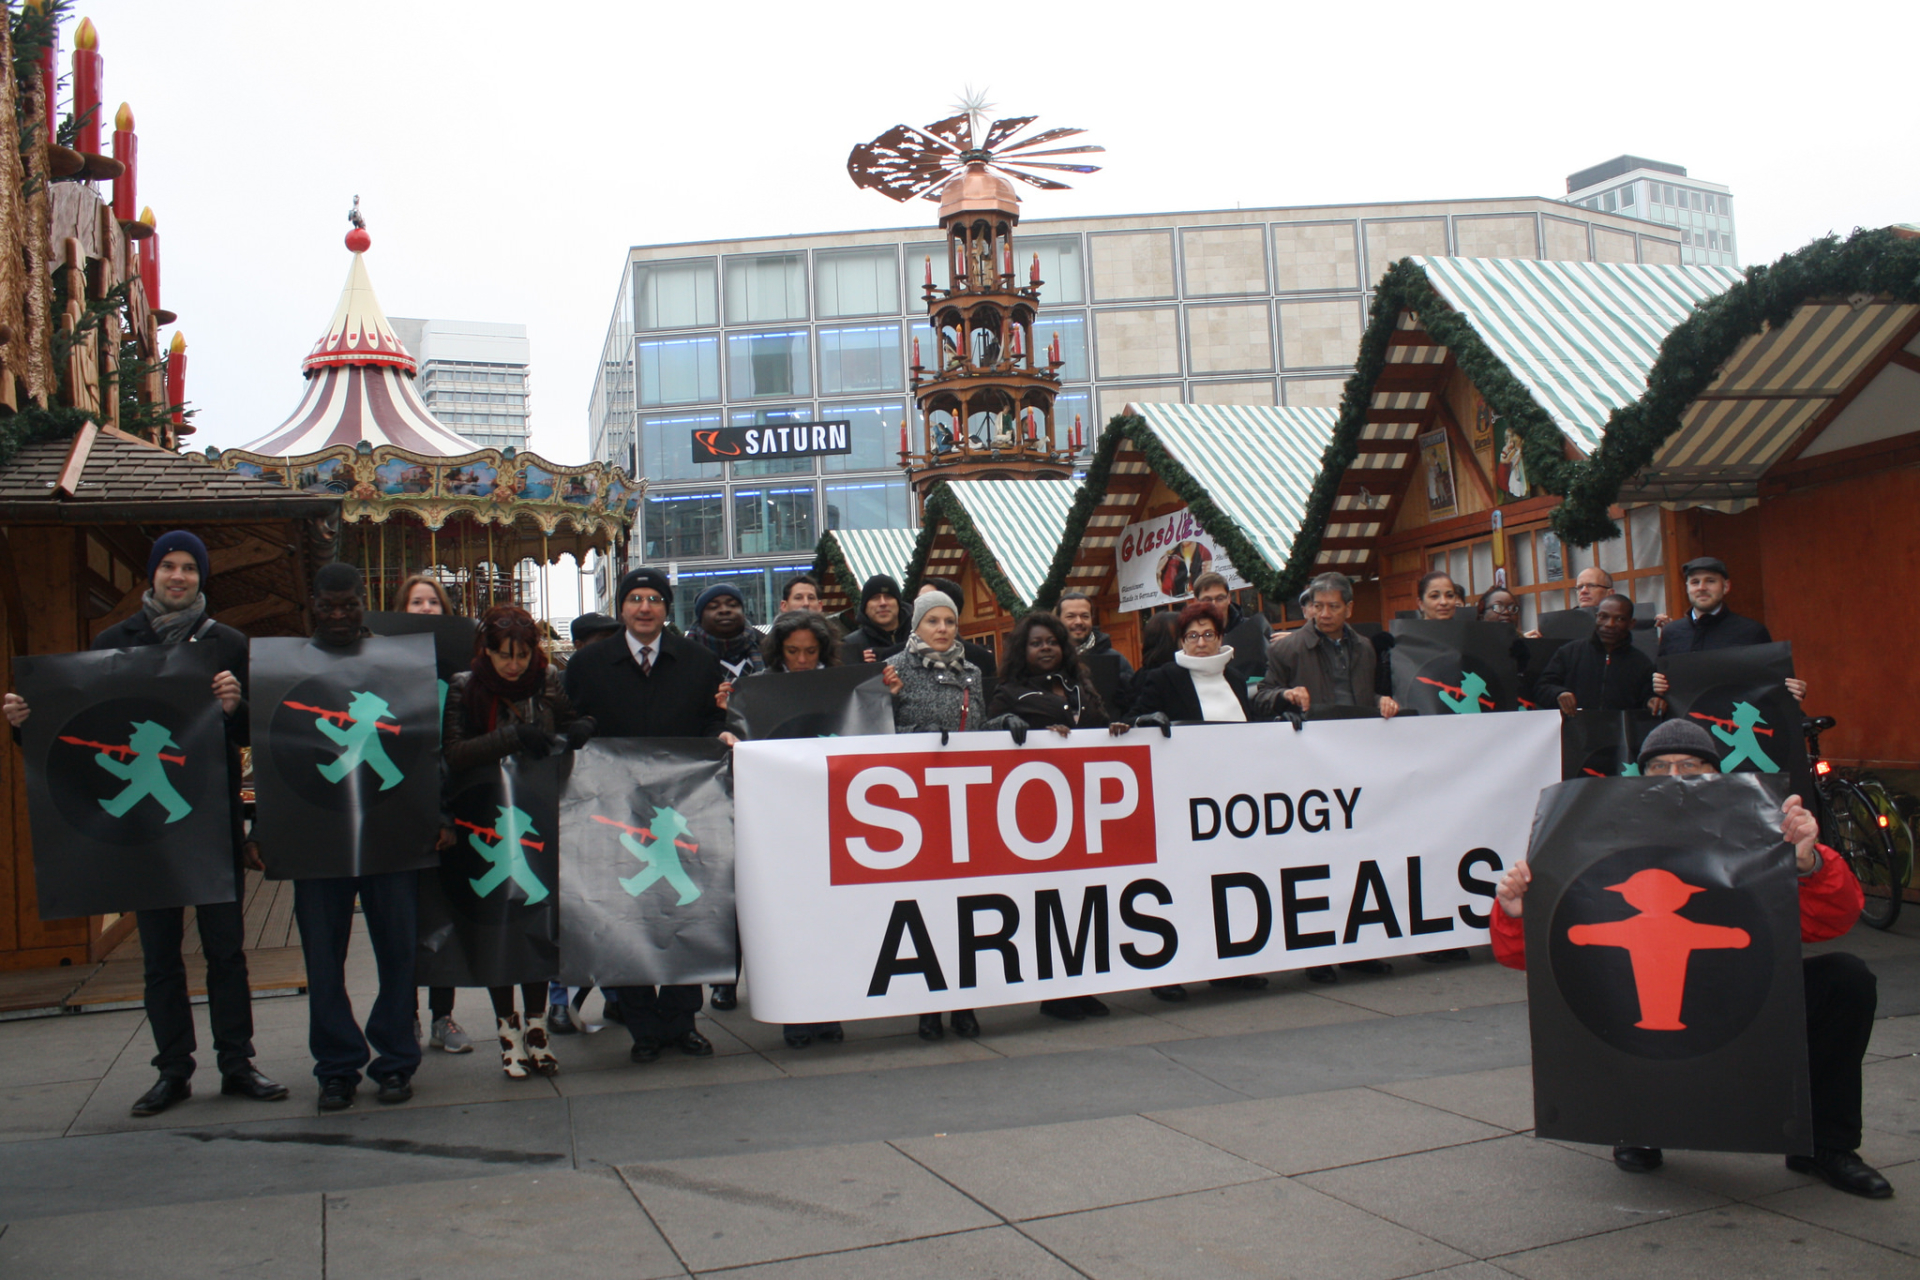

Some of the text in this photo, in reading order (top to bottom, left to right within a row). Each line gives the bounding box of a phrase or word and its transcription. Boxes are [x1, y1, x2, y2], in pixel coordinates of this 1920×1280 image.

[745, 424, 847, 455] SATURN
[845, 761, 1362, 870] STOP DODGY
[866, 847, 1504, 997] ARMS DEALS
